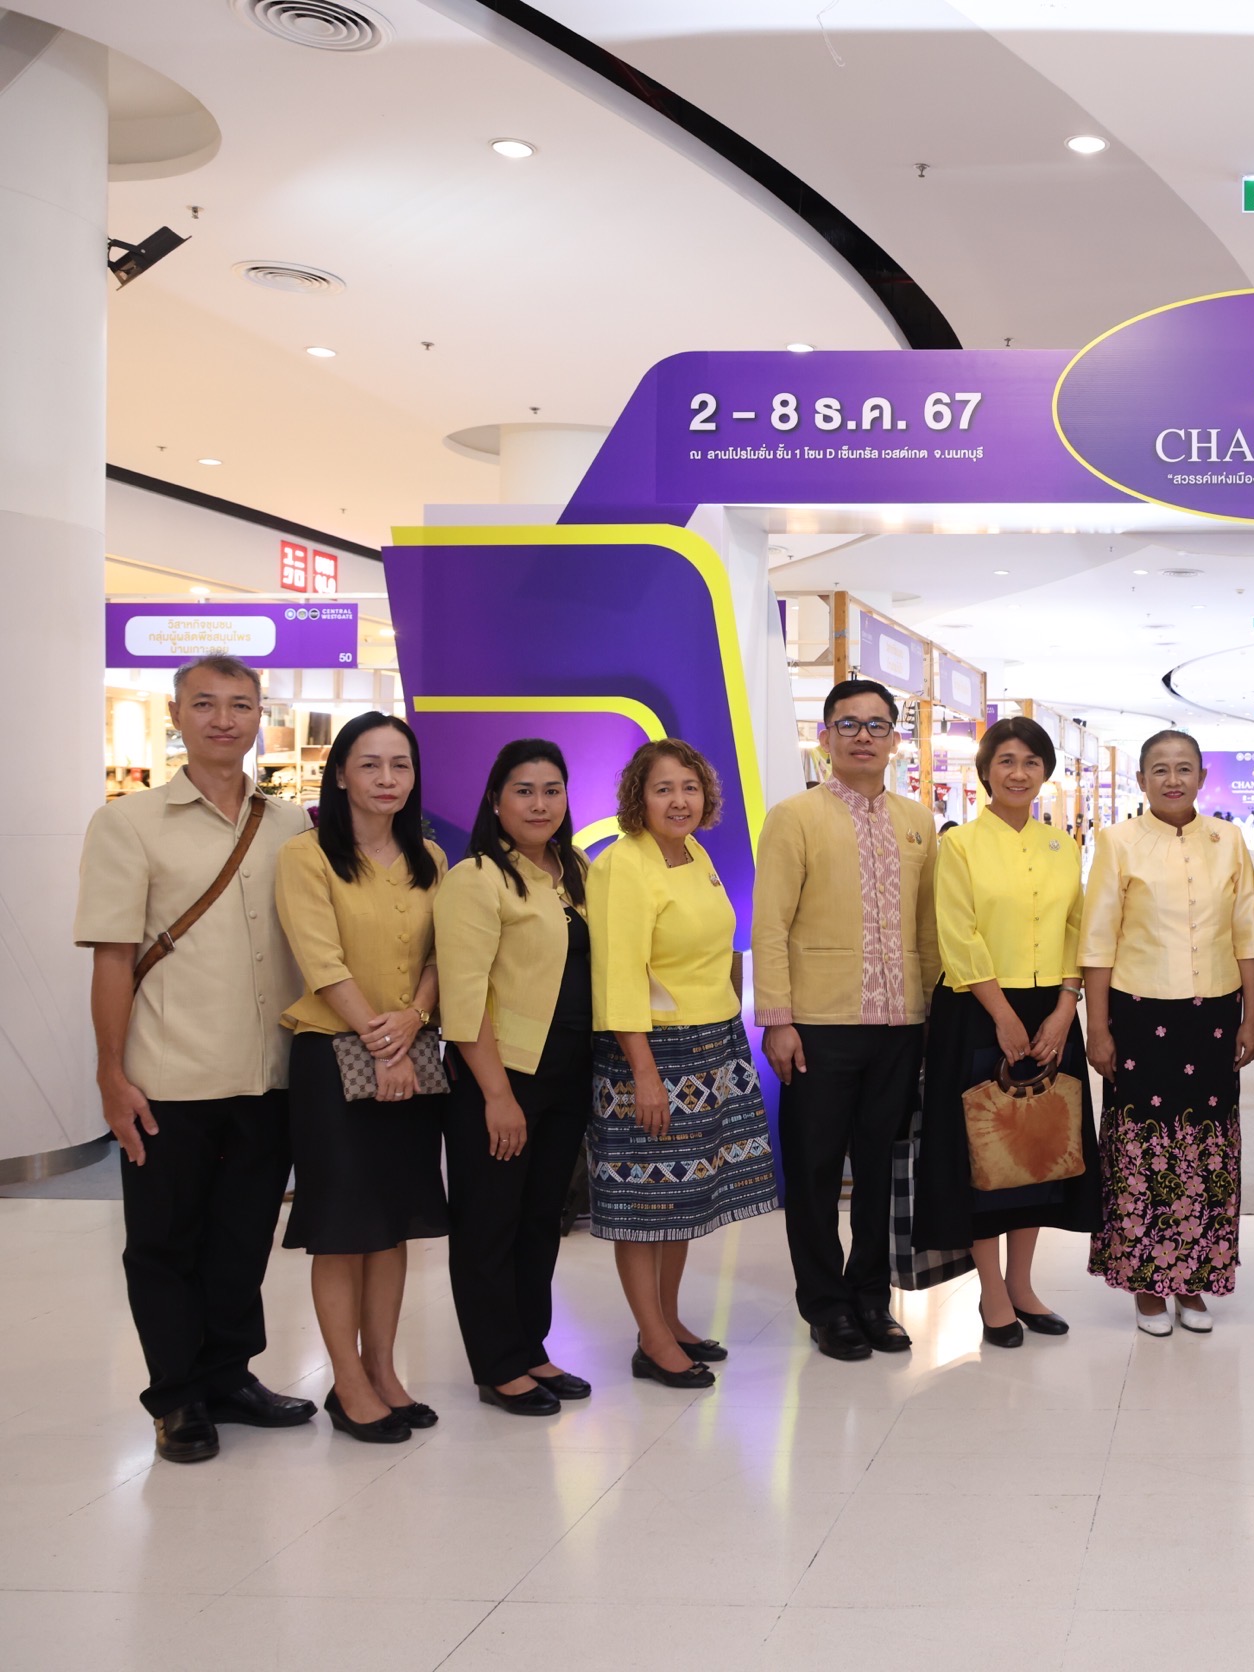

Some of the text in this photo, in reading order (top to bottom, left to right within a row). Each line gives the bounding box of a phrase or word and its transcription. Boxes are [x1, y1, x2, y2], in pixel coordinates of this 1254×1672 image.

[689, 393, 717, 431] 2
[770, 393, 798, 431] 8
[814, 397, 907, 431] ธ.ค.
[923, 392, 982, 430] 67
[690, 444, 984, 462] ณ ลานโปรโมชั่น ชั้น 1 โซน D เซ็นทรัล เวสต์เกต จ.นนทบุรี
[339, 653, 353, 662] 50
